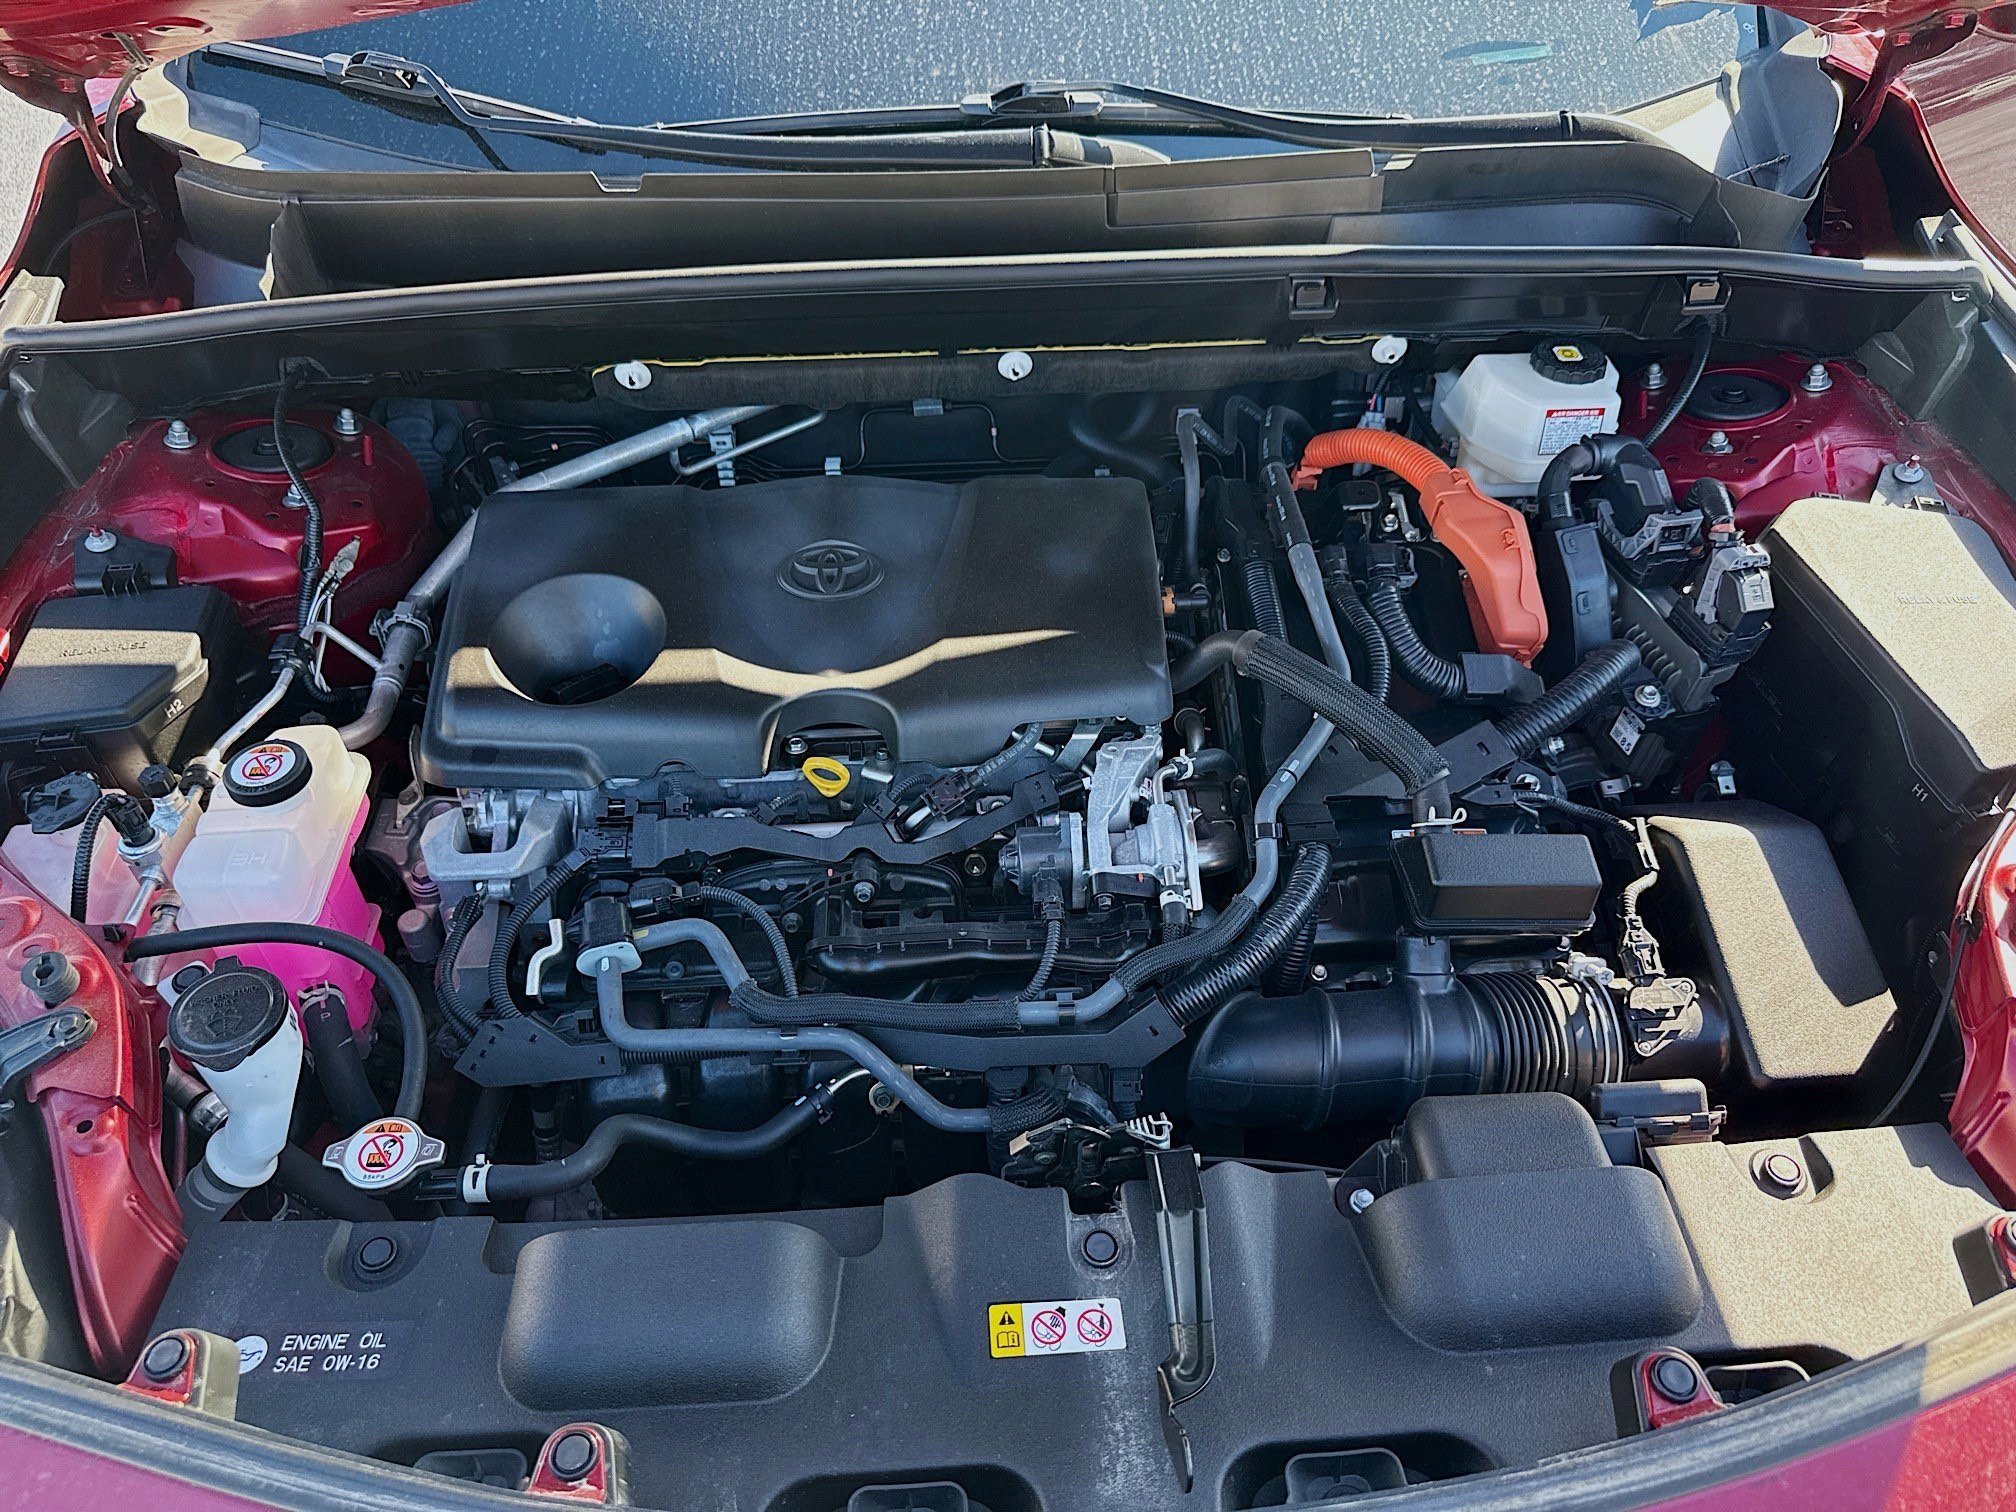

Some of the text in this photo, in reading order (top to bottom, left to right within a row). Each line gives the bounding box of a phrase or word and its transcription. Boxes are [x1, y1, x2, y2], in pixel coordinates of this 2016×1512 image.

[59, 645, 98, 658] RELAY
[113, 640, 149, 652] FUSE
[164, 698, 185, 719] H2
[1911, 783, 1929, 802] H1
[232, 984, 259, 998] FLUID
[213, 999, 235, 1009] ONLY
[280, 1332, 387, 1351] ENGINE OIL
[272, 1353, 382, 1373] SAE 0W-16
